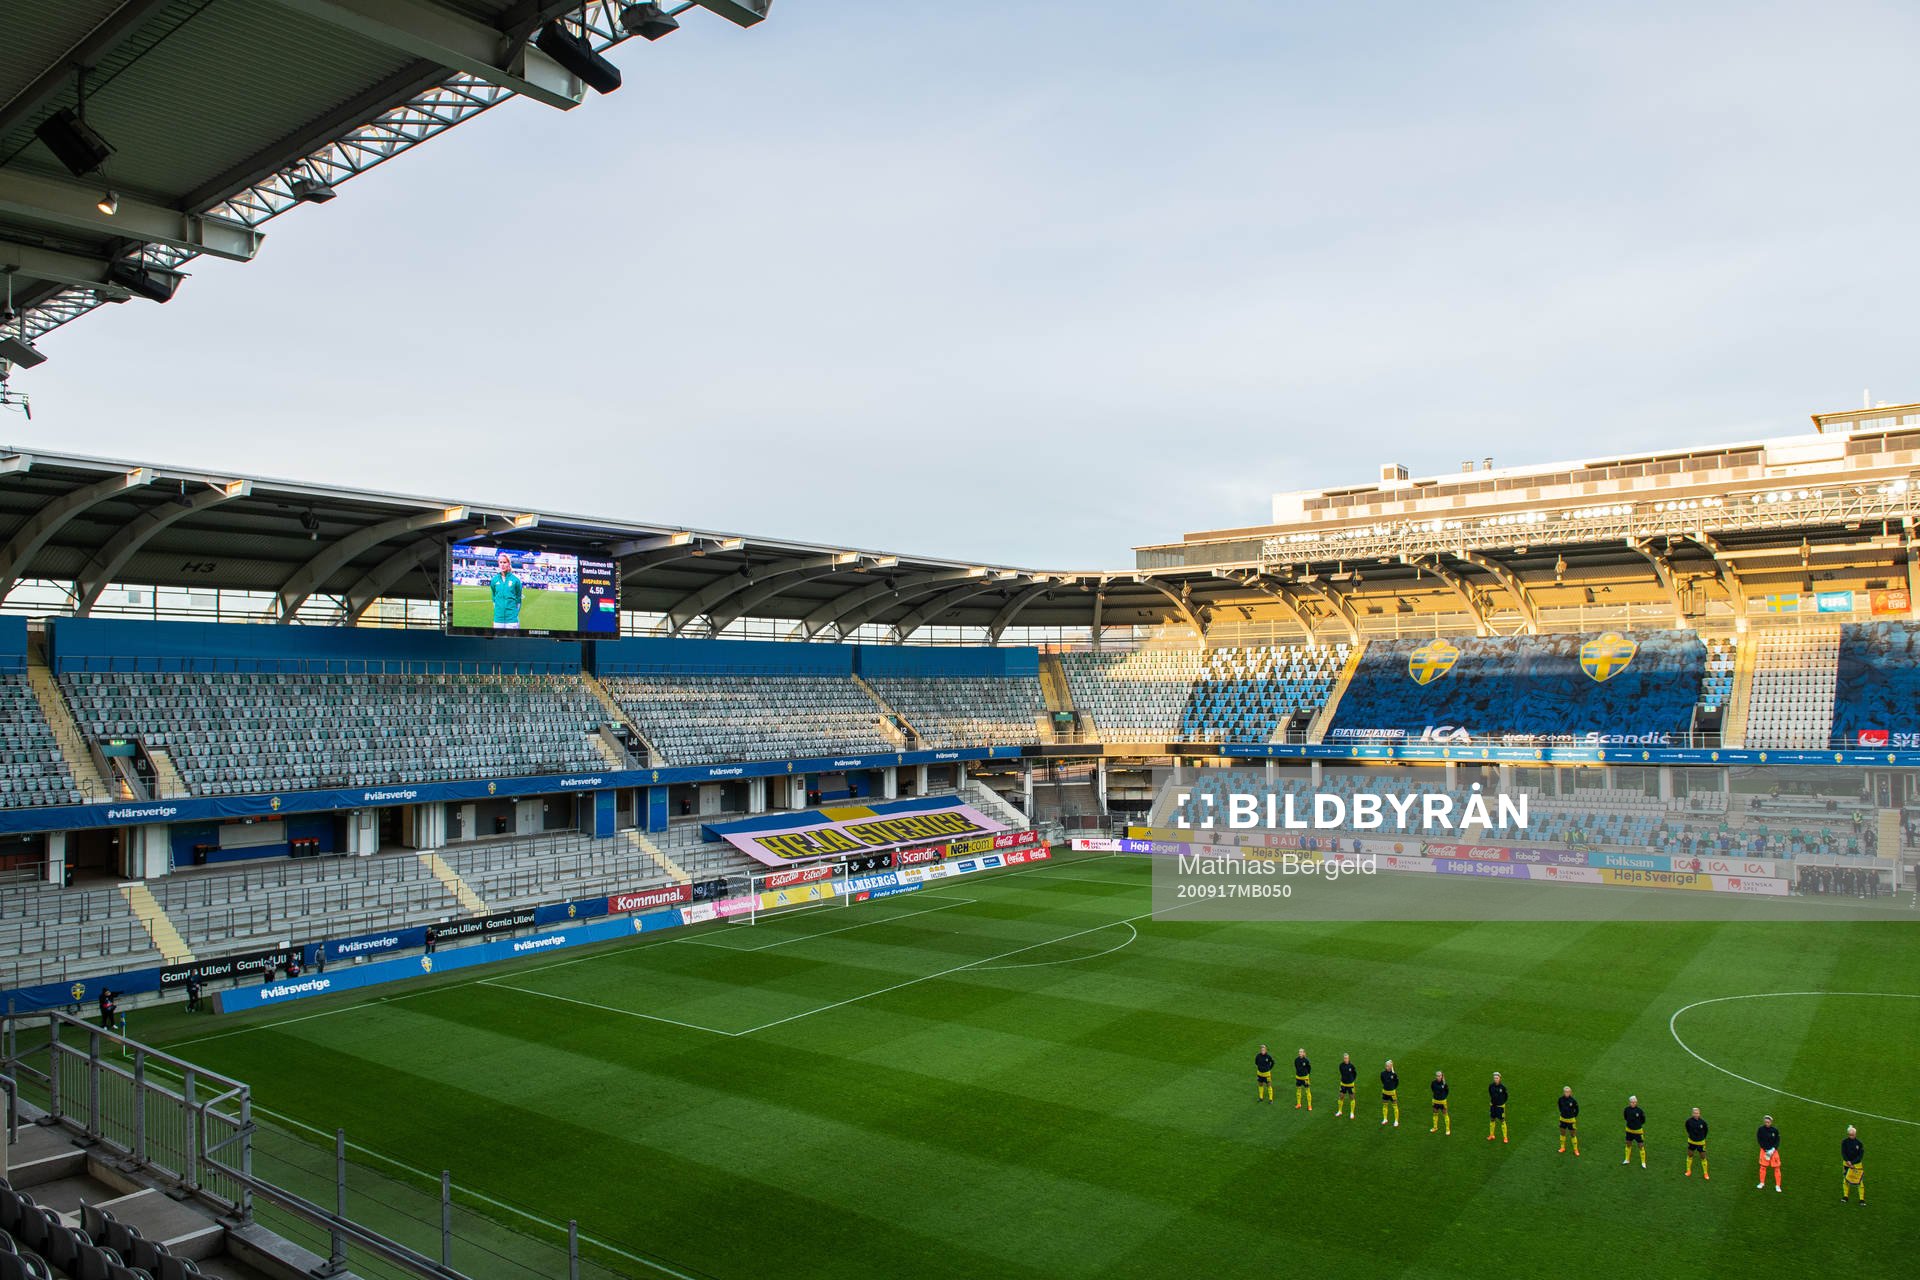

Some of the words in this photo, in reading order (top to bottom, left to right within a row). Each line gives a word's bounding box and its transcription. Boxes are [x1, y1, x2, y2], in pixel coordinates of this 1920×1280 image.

[180, 562, 217, 574] H3
[589, 586, 604, 594] 4.50
[1332, 728, 1406, 737] BAUHAUS
[1420, 725, 1473, 743] ICA
[1585, 731, 1671, 744] Scandic
[364, 788, 417, 801] #viärsverige
[107, 806, 177, 818] #viärsverige
[754, 827, 869, 859] HEJA
[844, 811, 987, 847] SVERIGE
[1130, 841, 1149, 852] Heja
[1271, 836, 1333, 848] BAUUS
[1252, 847, 1273, 859] Heja
[1469, 847, 1501, 860] Coca-Cola
[1606, 855, 1654, 868] Folksam
[1708, 861, 1729, 872] ICA
[1744, 863, 1766, 874] ICA
[1448, 861, 1474, 875] Heja
[1476, 862, 1514, 877] Seger!
[832, 873, 897, 895] MALMBERGS
[1614, 869, 1642, 883] Heja
[1644, 870, 1697, 886] Sverige!
[459, 922, 482, 933] Ullevi
[486, 918, 512, 929] Gamla
[513, 913, 535, 925] Ullevi
[338, 935, 398, 954] #viärsverige
[513, 935, 566, 952] #viärsverige
[200, 963, 231, 977] Ullevi
[260, 978, 330, 1000] #viärsverige
